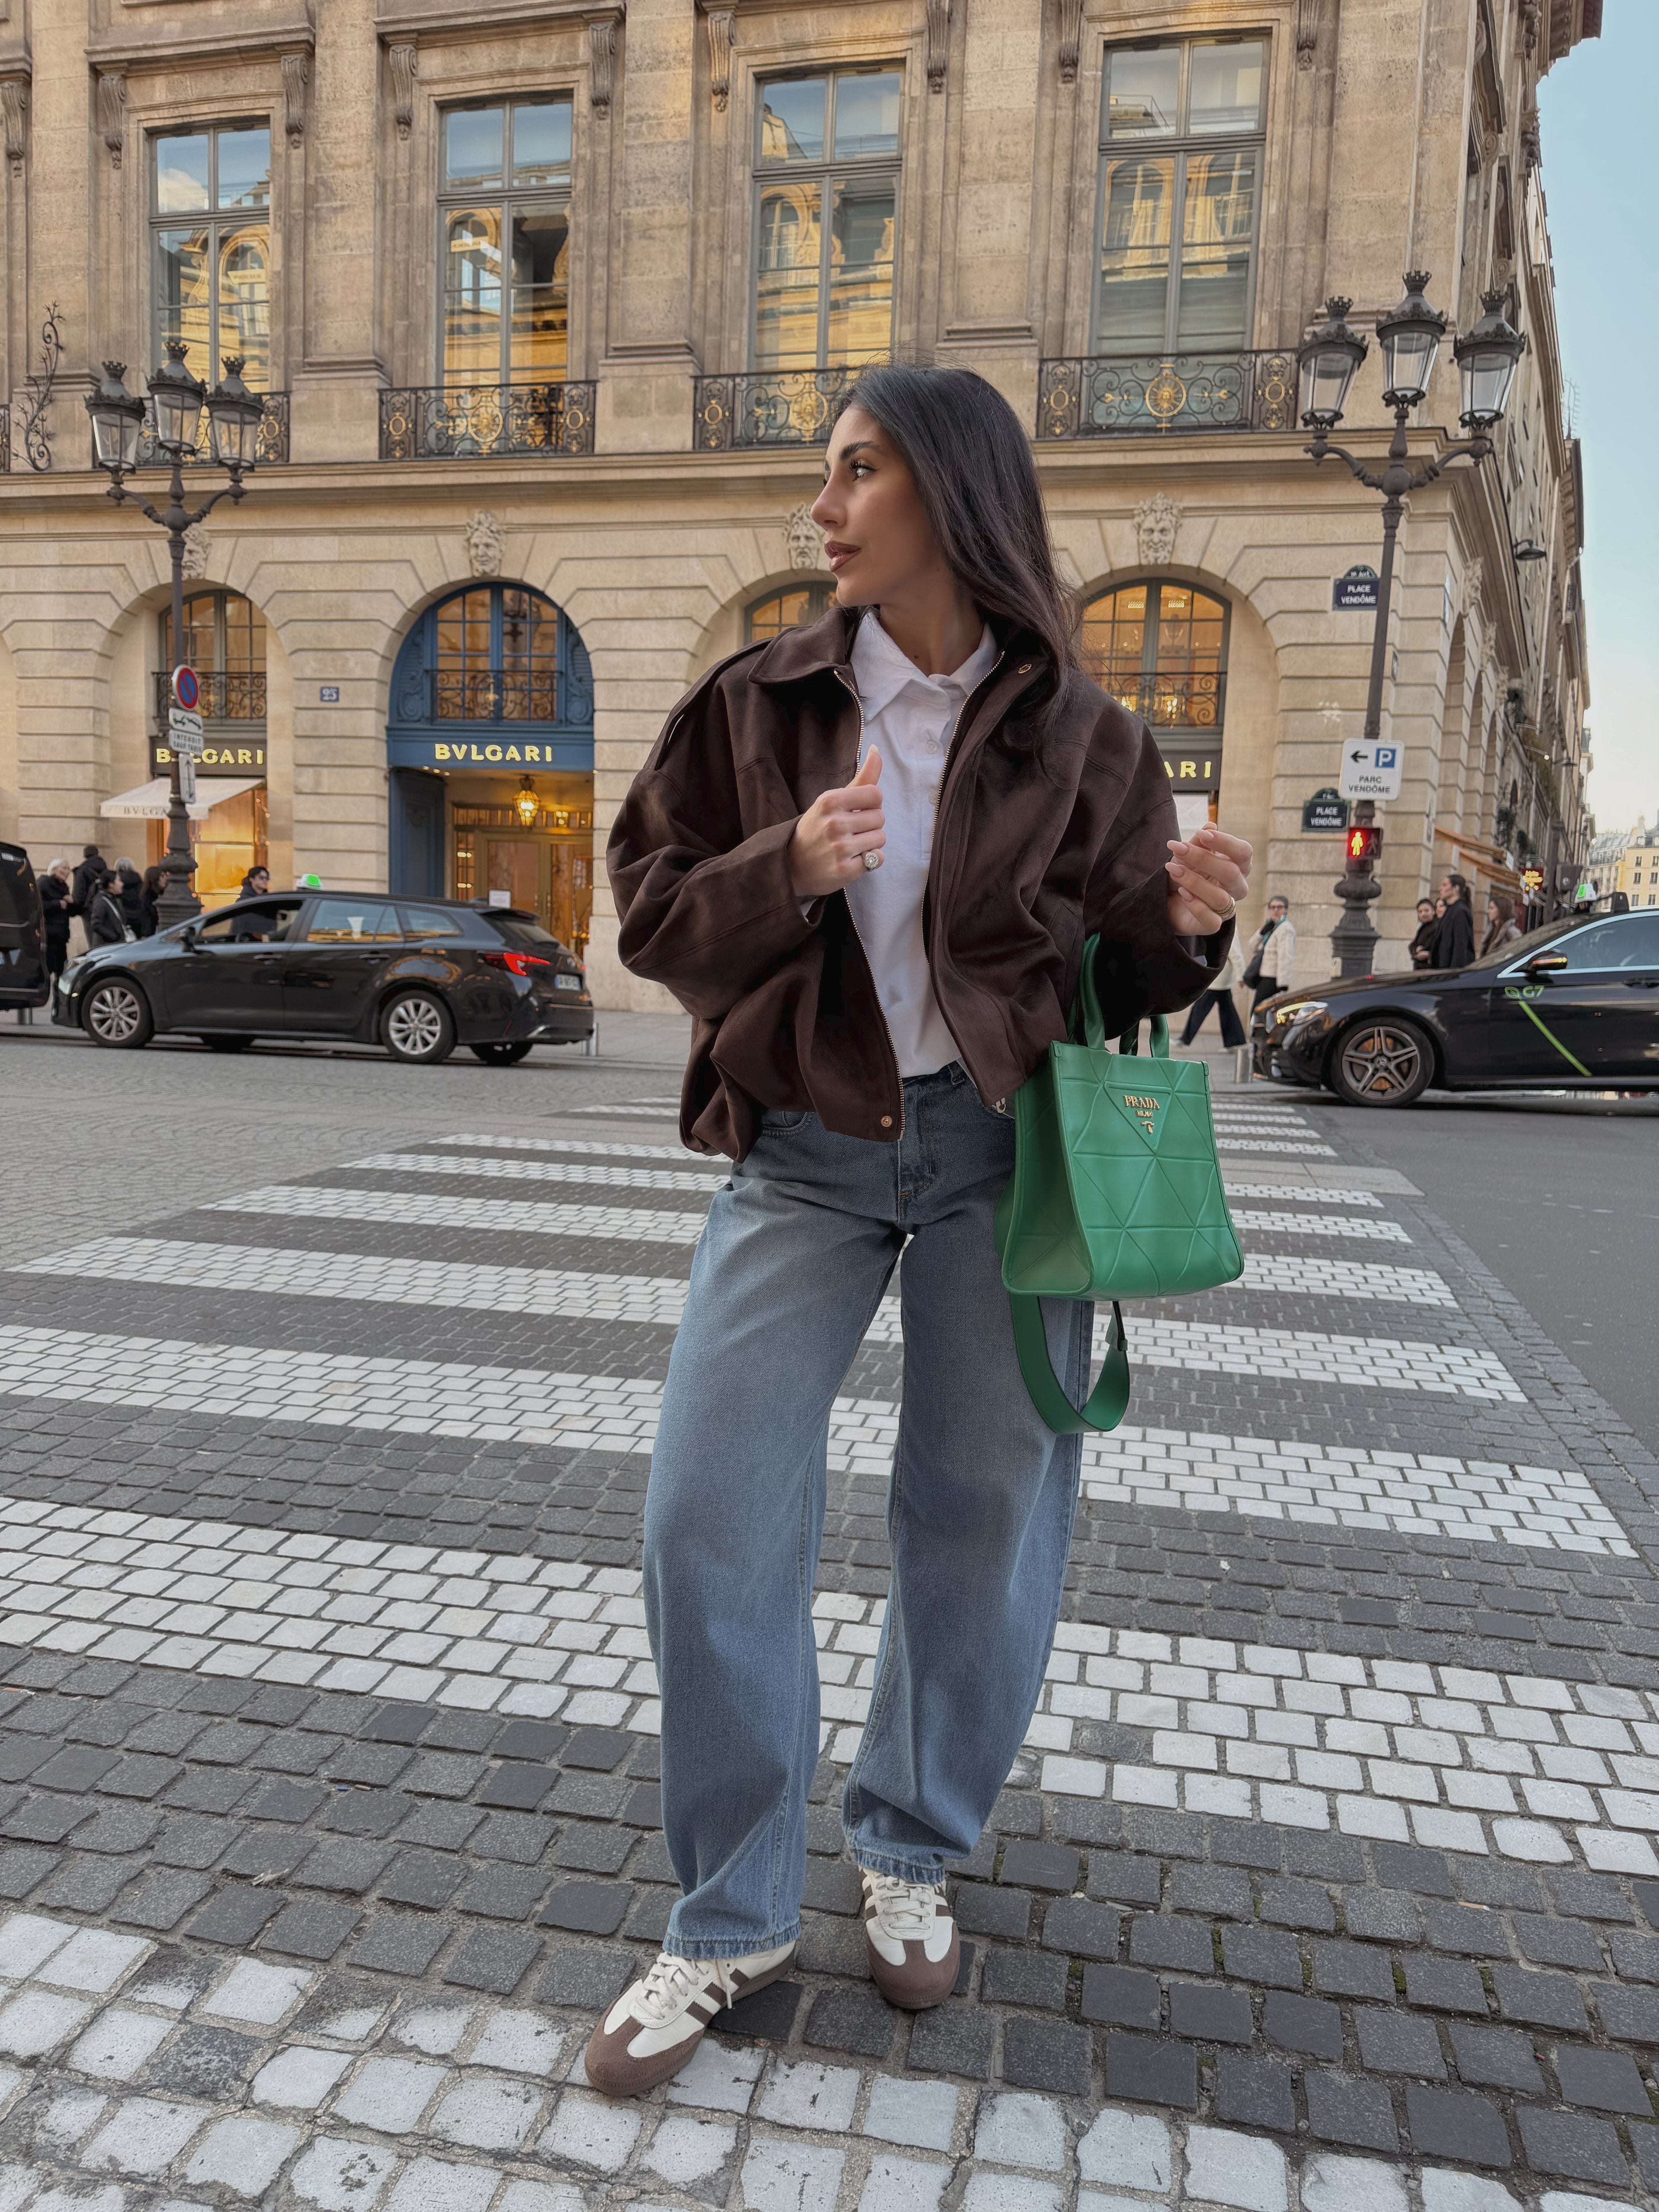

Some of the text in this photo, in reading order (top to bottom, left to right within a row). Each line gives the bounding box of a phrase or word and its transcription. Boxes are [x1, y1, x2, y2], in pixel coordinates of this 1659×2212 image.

[1347, 585, 1371, 593] PLACE
[1341, 594, 1376, 604] VENDÔME
[435, 744, 552, 762] BVLGARI
[1378, 750, 1392, 767] P
[1359, 775, 1382, 784] PARC
[1348, 784, 1391, 794] VENDÔME
[1316, 807, 1338, 815] PLACE
[1310, 816, 1342, 826] VENDÔME
[1522, 985, 1545, 998] G7
[1124, 1095, 1160, 1109] PRADA
